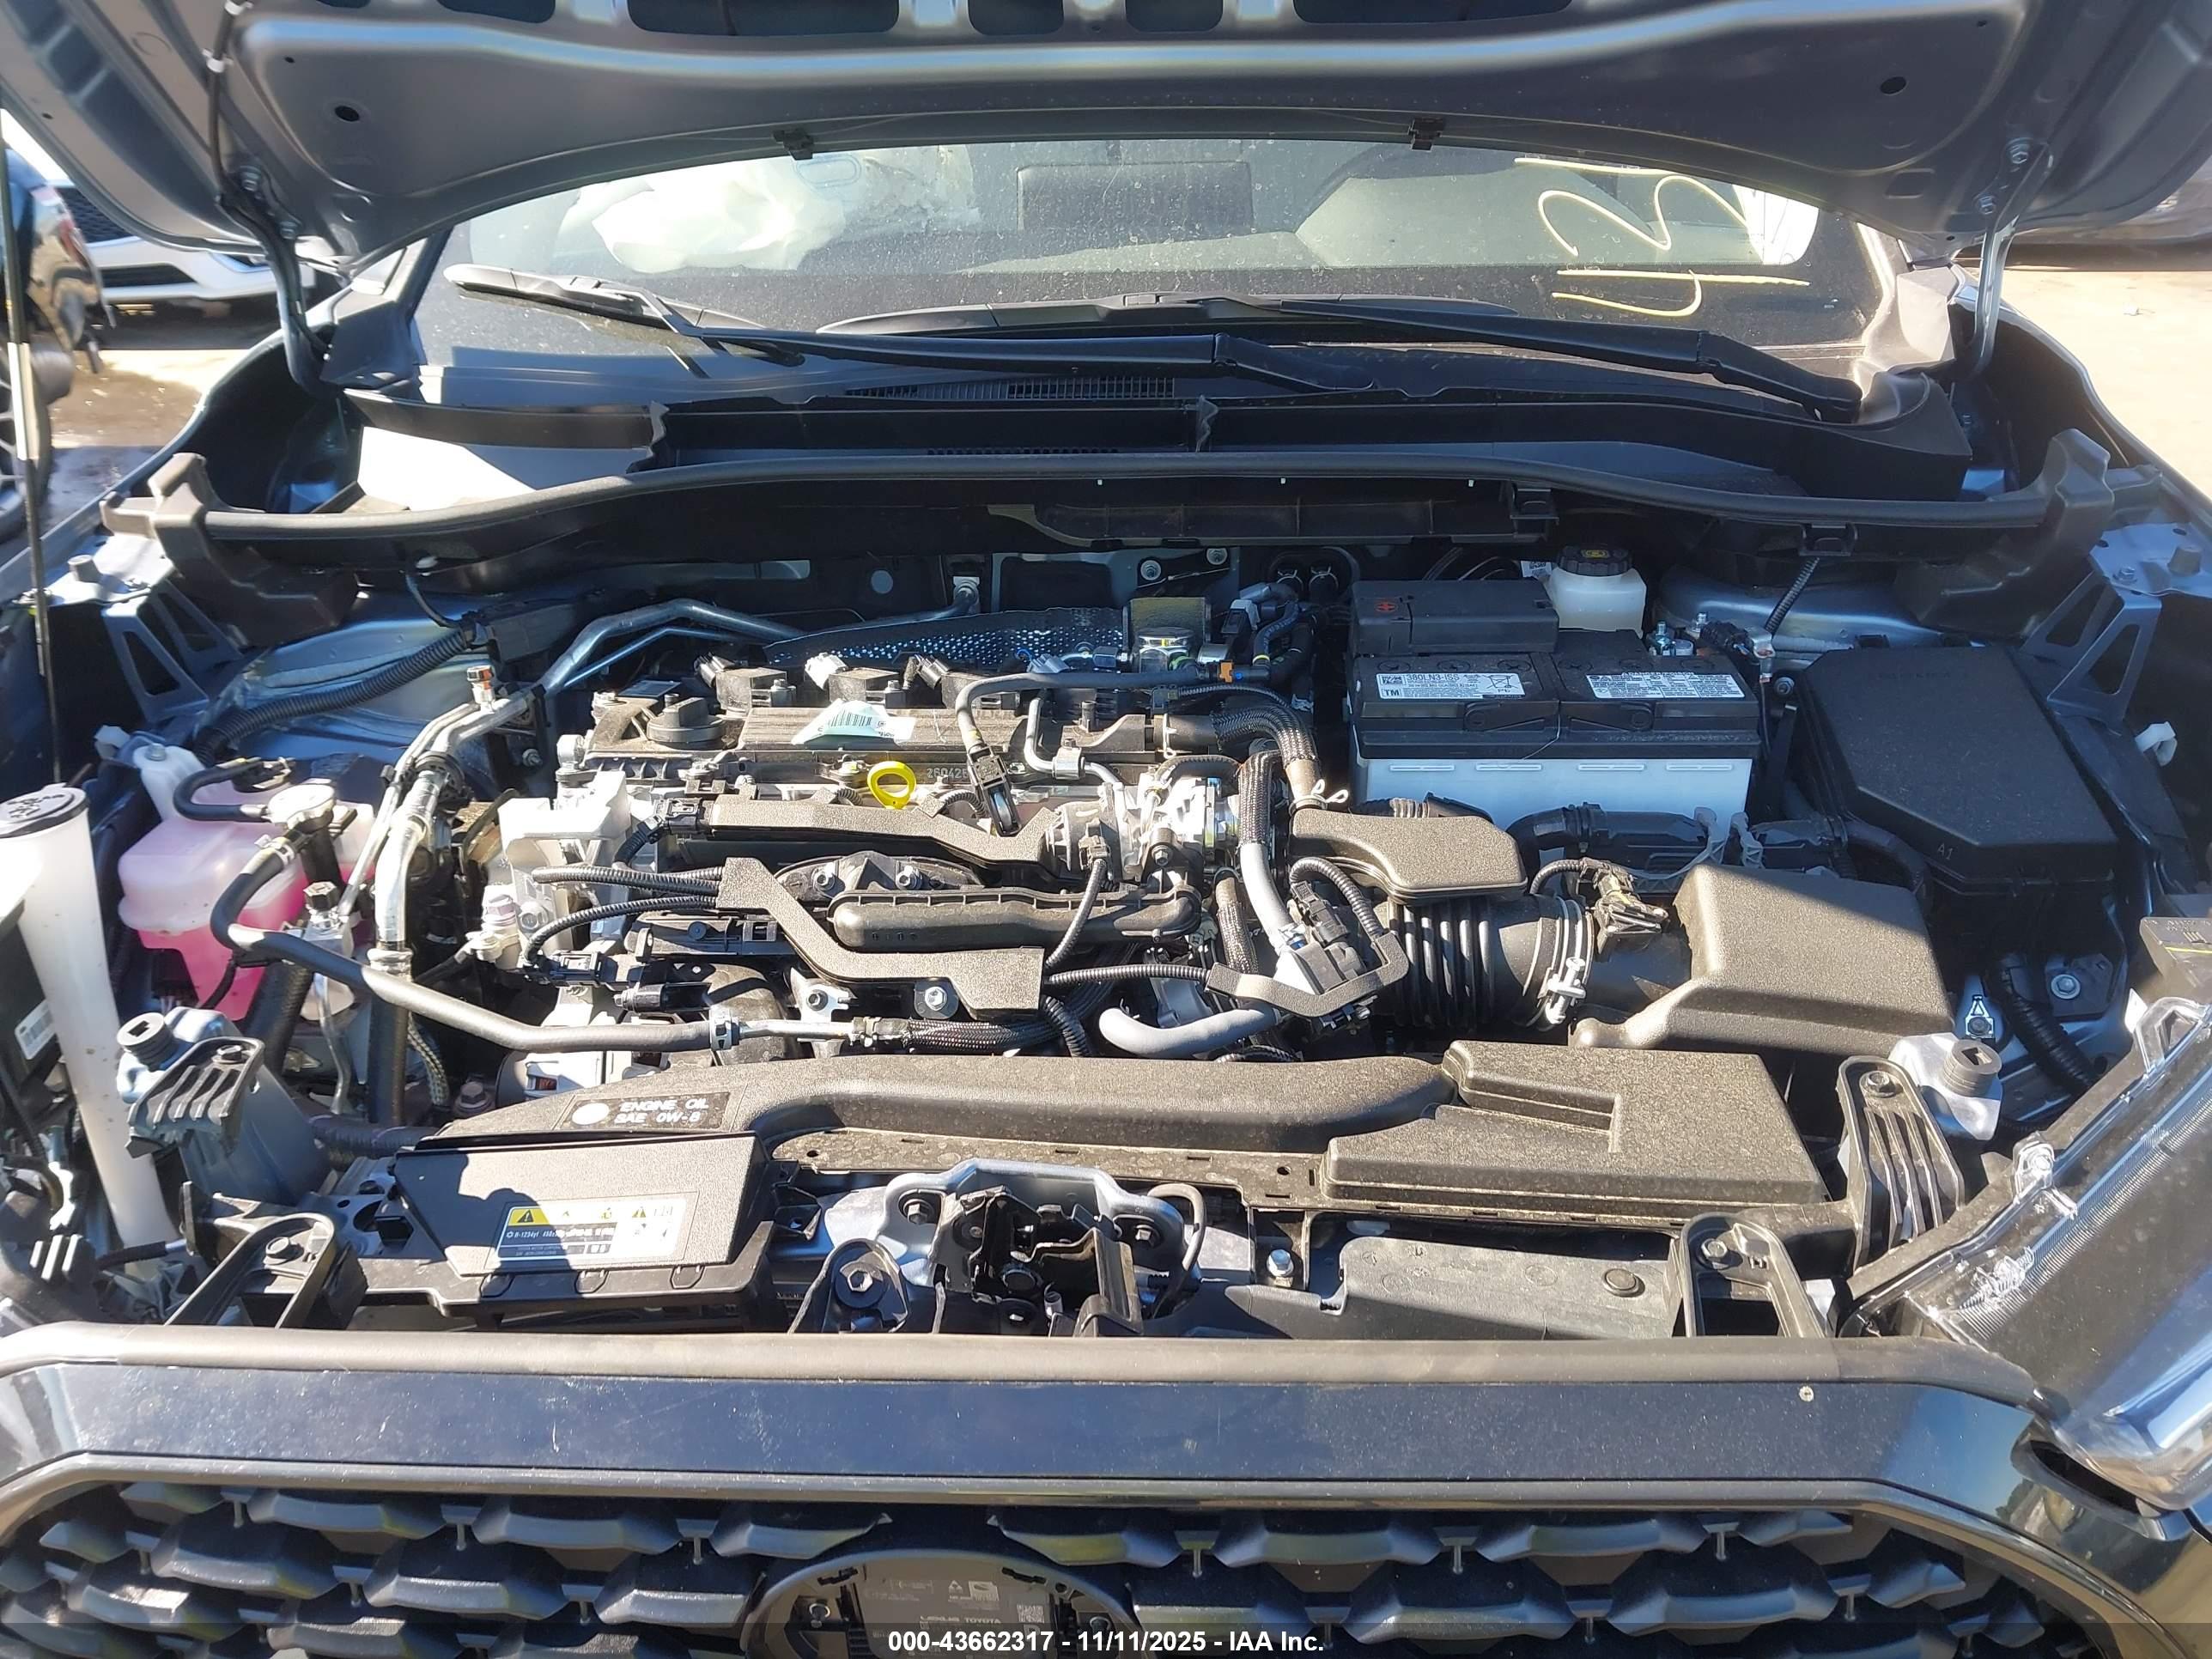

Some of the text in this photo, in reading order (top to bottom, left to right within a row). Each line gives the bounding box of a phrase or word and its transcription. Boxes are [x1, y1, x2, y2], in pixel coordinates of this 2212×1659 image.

[619, 1098, 709, 1112] ENGINE OIL
[614, 1113, 647, 1124] SAE
